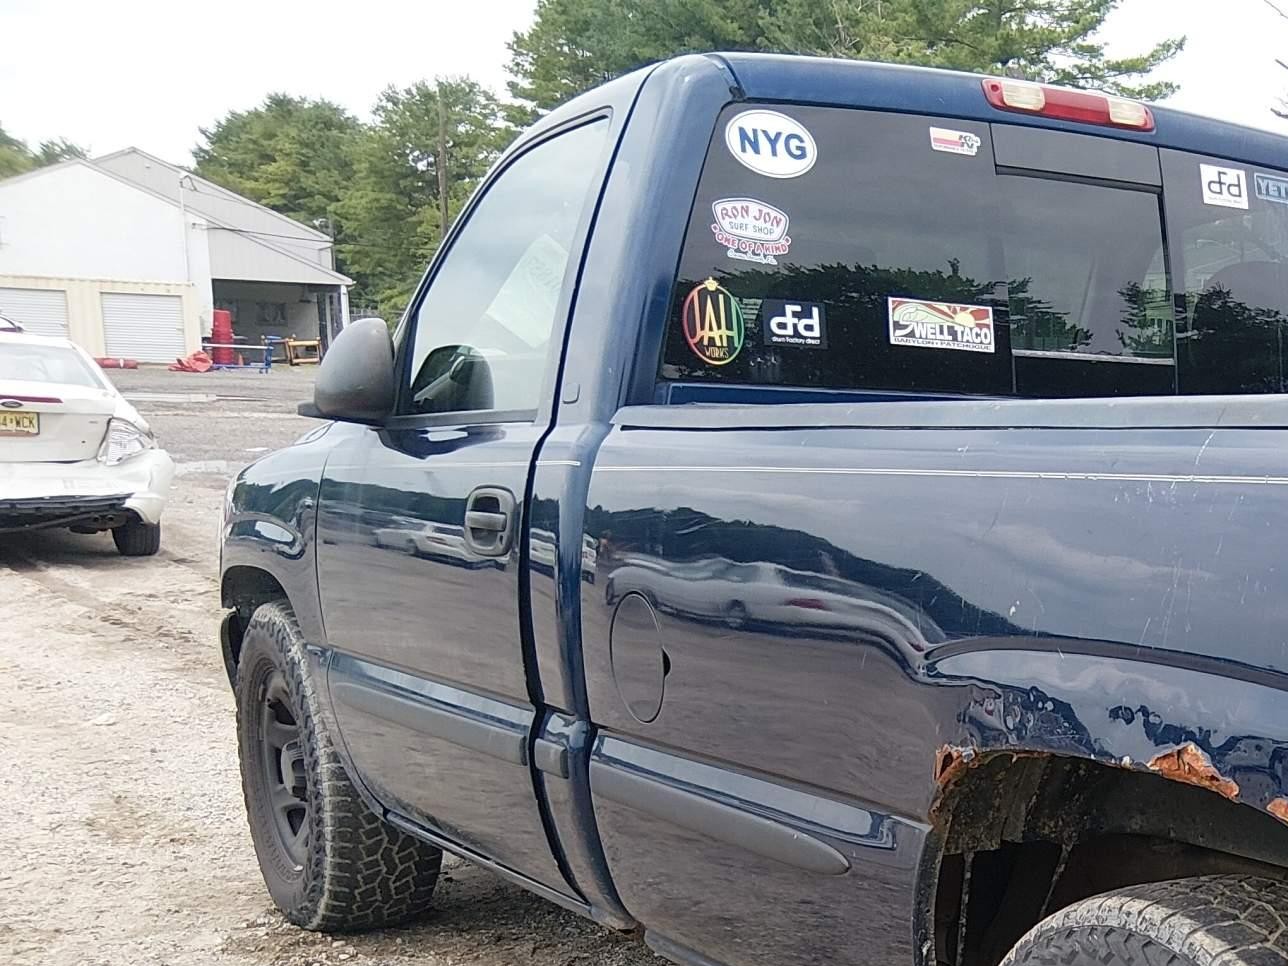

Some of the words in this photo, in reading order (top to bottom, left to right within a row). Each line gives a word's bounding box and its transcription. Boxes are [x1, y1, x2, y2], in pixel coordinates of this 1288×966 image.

[738, 126, 808, 161] NYG
[720, 205, 750, 221] RON
[752, 209, 782, 228] JON
[728, 221, 749, 232] SURF
[752, 224, 775, 236] SHOP
[716, 232, 738, 248] ONE
[739, 241, 754, 252] OF
[764, 243, 788, 254] KIND
[953, 325, 991, 344] TACO
[703, 346, 729, 359] WORKS
